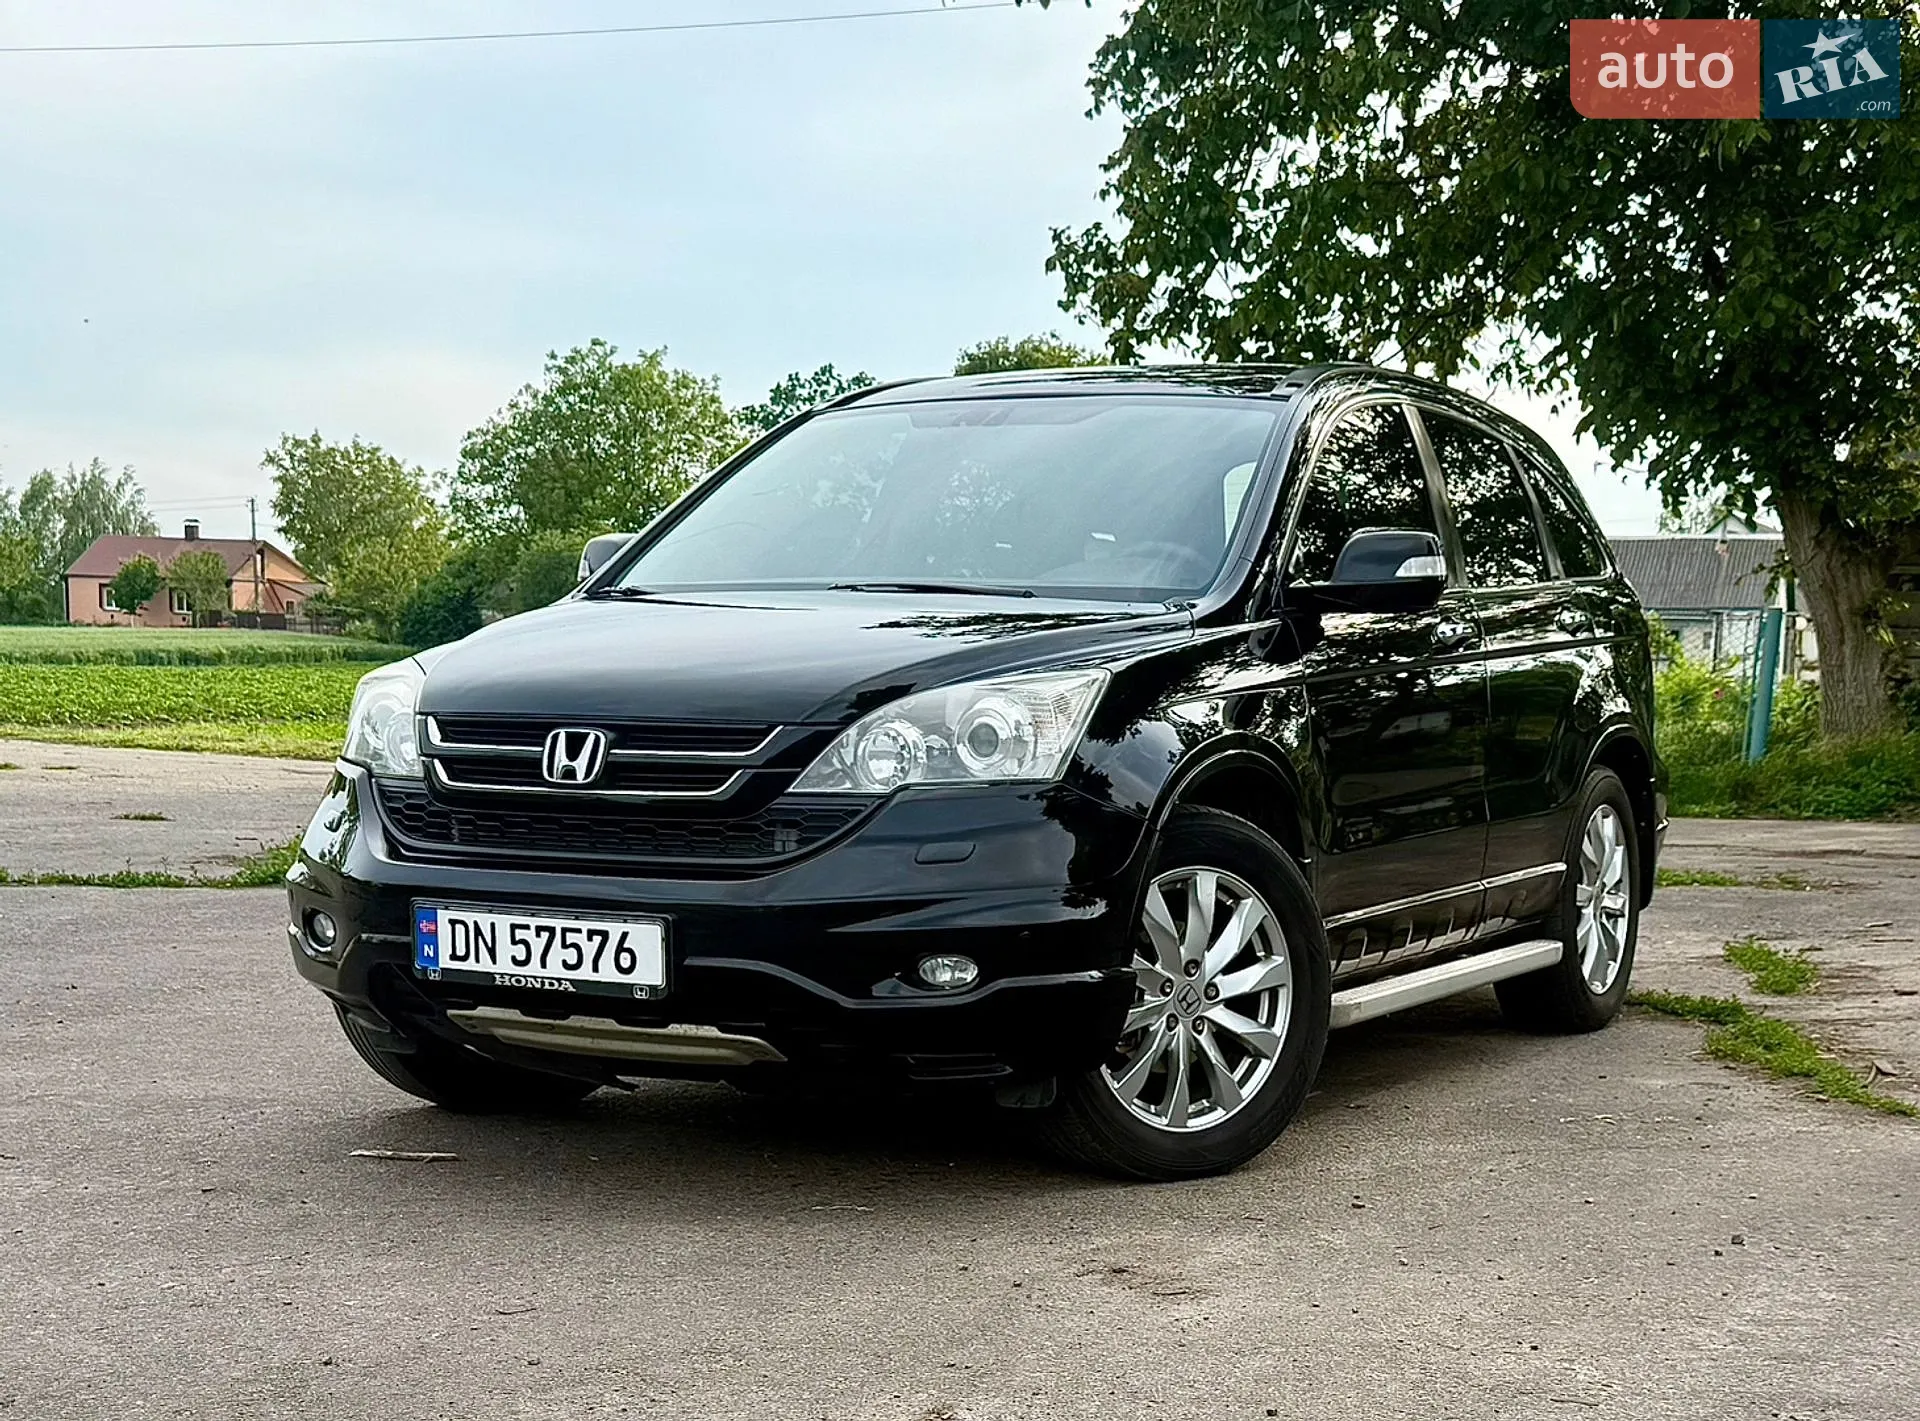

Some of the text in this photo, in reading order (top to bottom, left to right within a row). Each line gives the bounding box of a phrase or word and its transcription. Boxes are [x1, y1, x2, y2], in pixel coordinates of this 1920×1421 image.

[423, 943, 434, 957] N
[448, 918, 638, 975] DN 57576
[494, 974, 576, 991] HONDA
